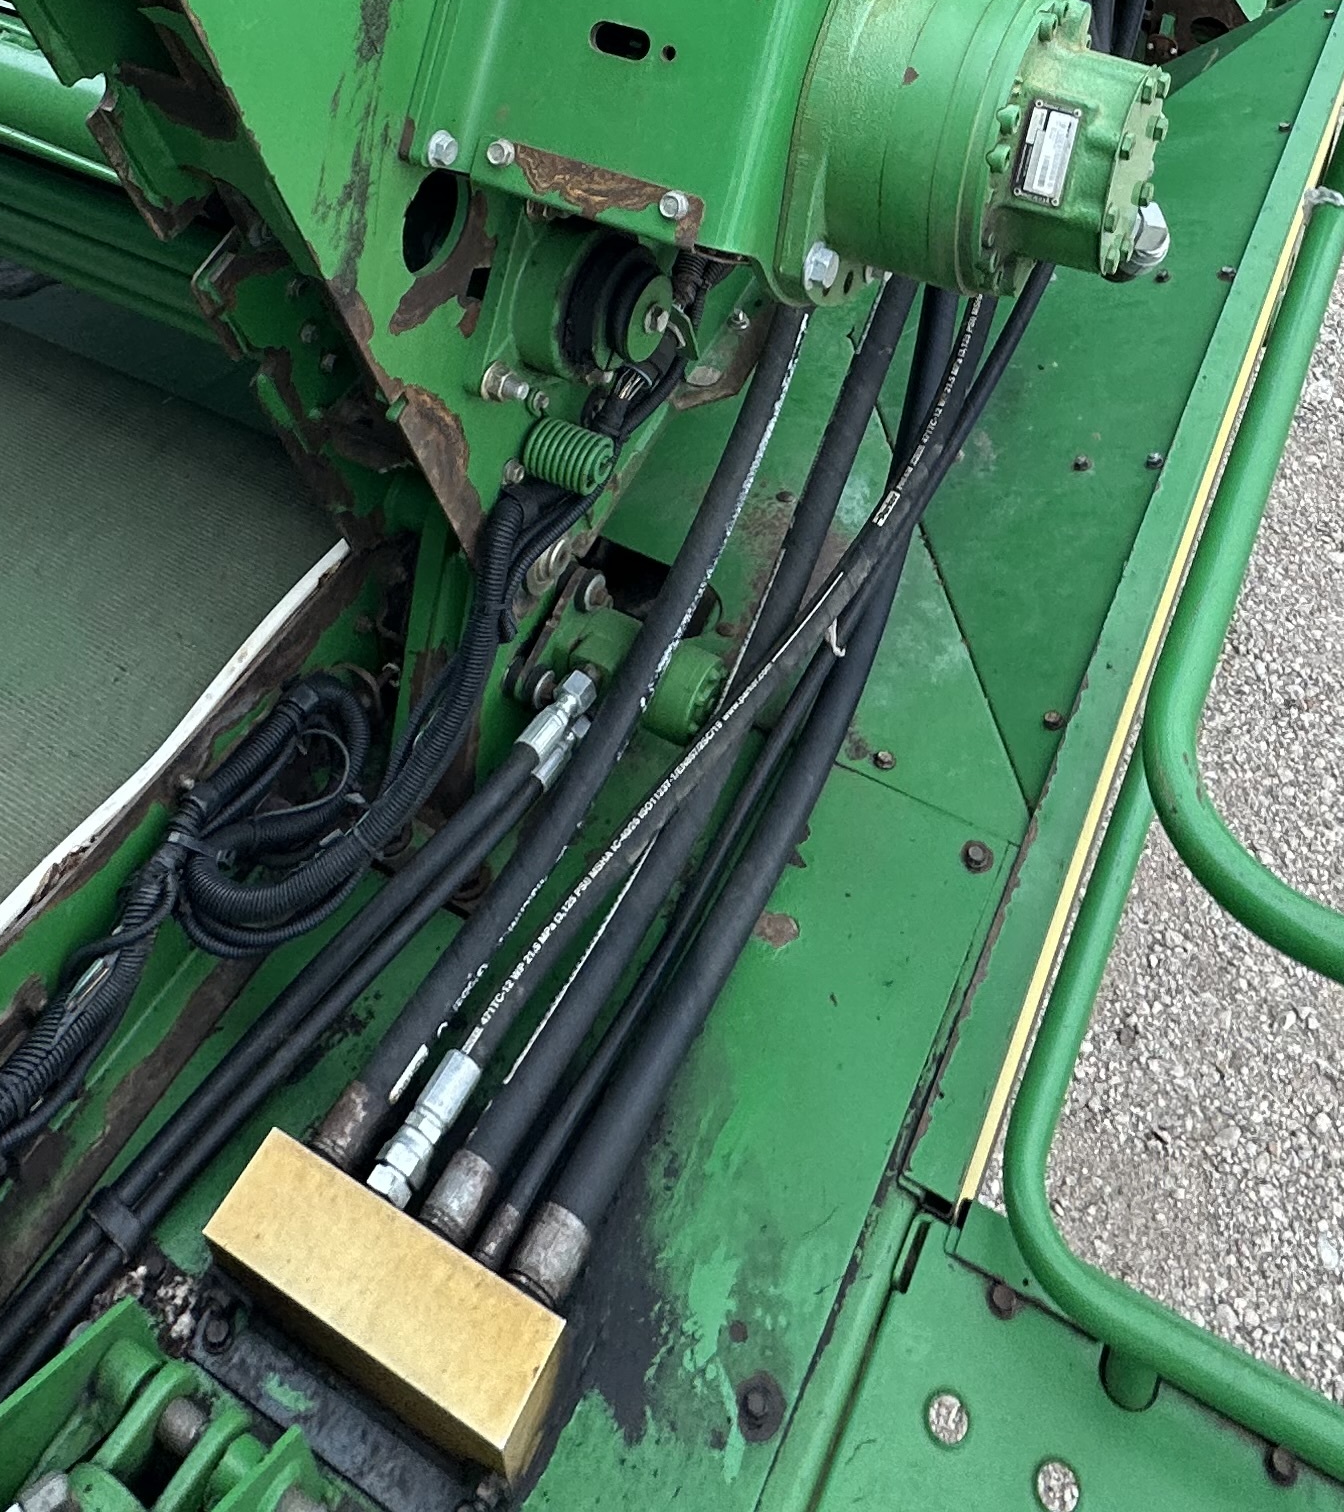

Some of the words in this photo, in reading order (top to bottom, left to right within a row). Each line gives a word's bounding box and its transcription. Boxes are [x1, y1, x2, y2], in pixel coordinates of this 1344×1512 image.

[478, 977, 516, 1026] 471TC-12
[510, 961, 528, 982] WP
[522, 940, 543, 965] 21.5
[537, 920, 557, 944] MPa
[587, 849, 614, 879] MSHA
